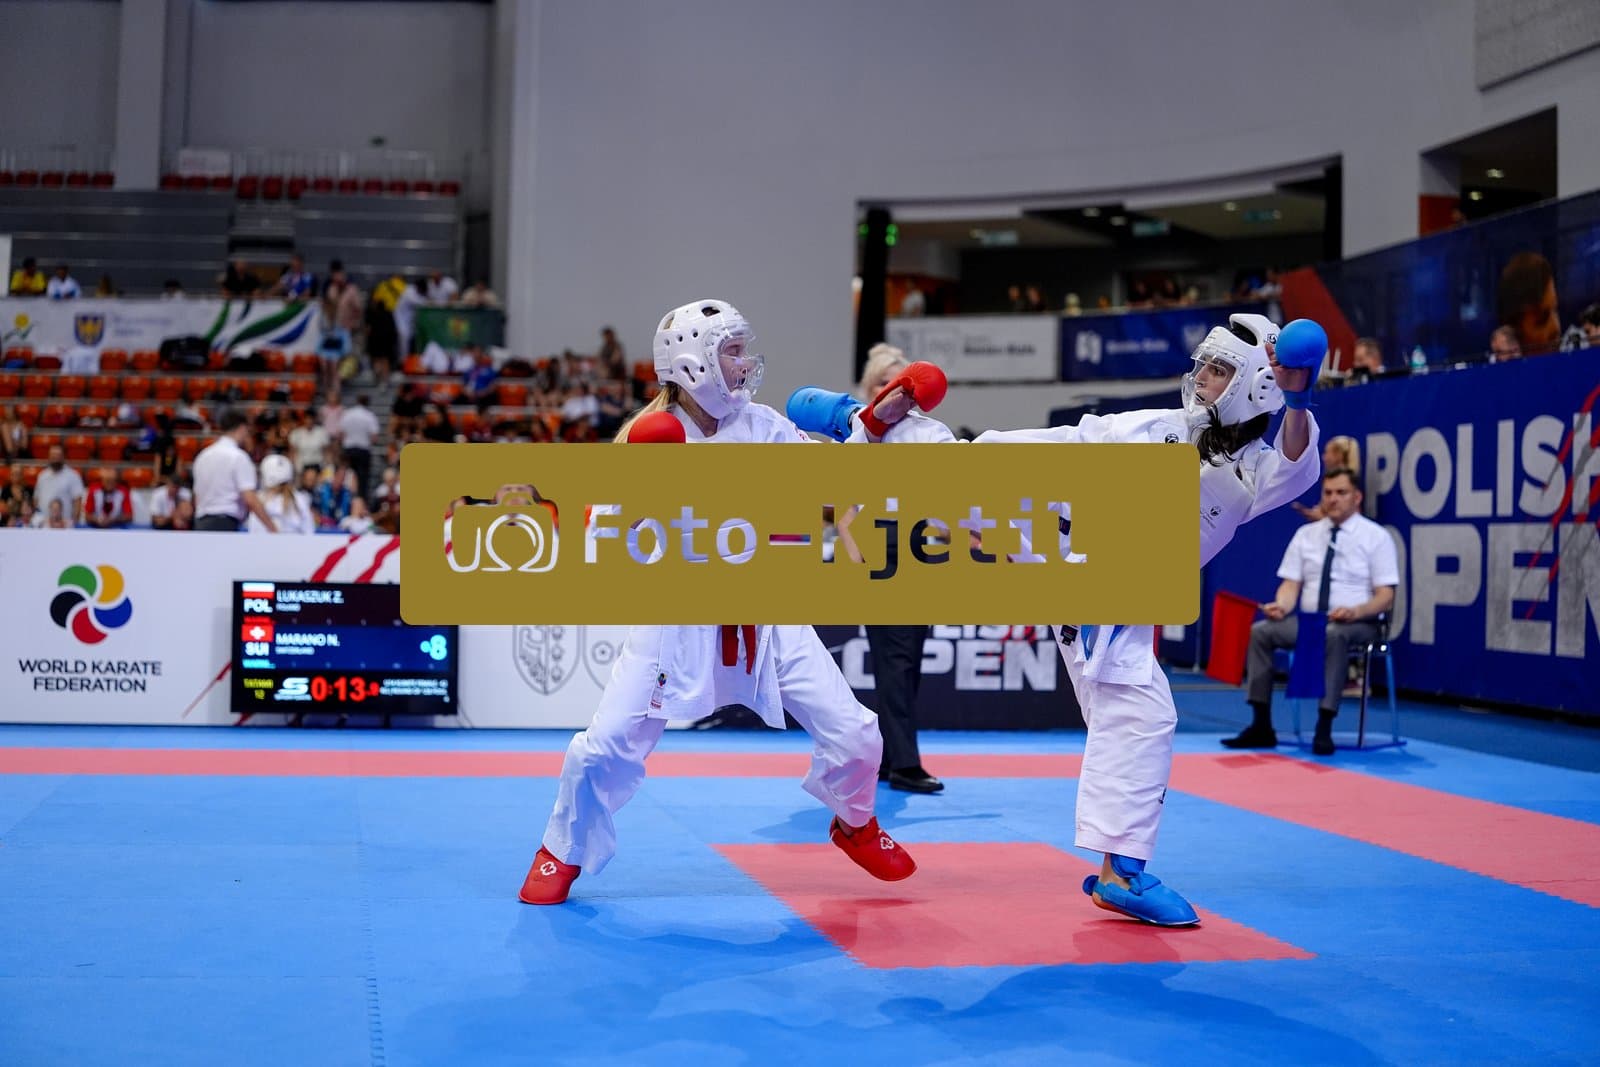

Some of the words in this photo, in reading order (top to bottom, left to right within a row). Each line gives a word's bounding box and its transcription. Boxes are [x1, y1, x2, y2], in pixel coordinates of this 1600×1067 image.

[243, 598, 274, 613] POL
[275, 633, 327, 647] MARANO
[245, 642, 270, 656] SUI
[18, 659, 87, 674] WORLD
[92, 661, 162, 676] KARATE
[33, 676, 146, 692] FEDERATION
